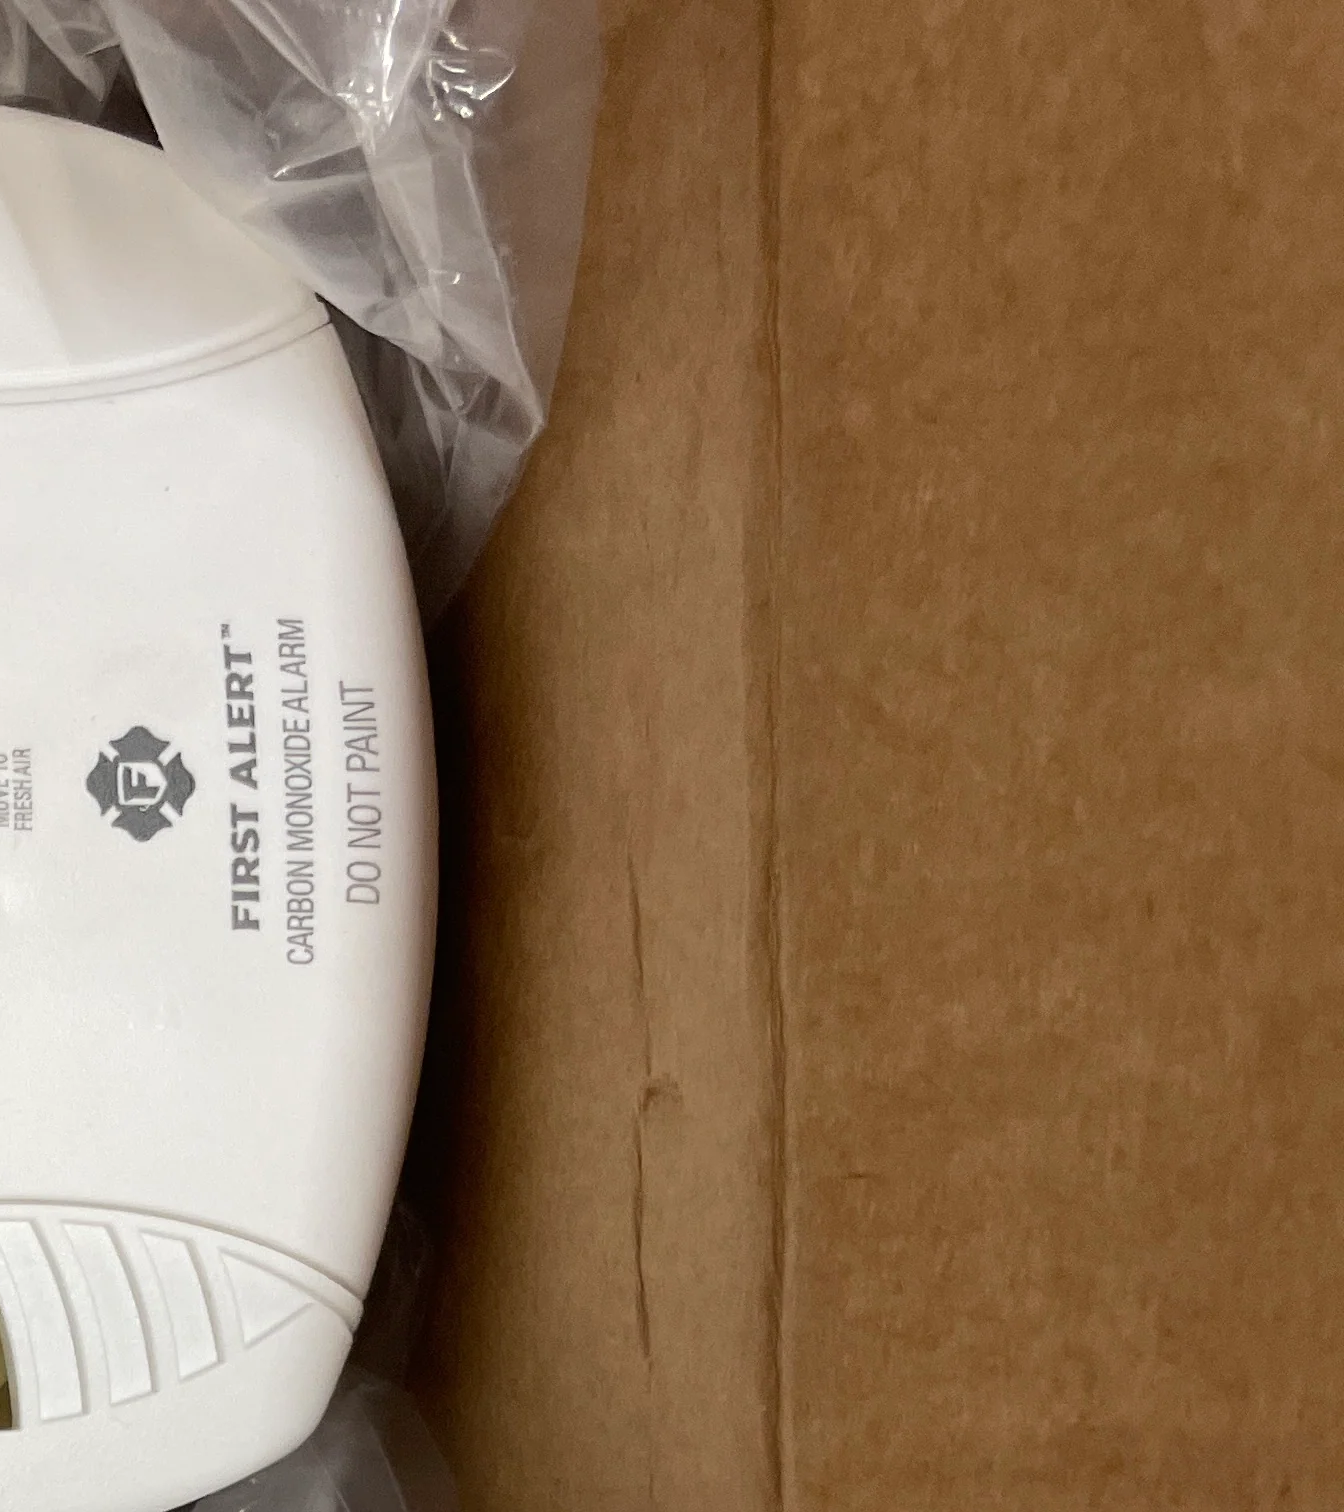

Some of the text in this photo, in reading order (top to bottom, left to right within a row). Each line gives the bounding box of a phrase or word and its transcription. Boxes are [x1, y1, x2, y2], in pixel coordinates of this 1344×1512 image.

[11, 748, 34, 831] FRESH AIR
[228, 802, 261, 931] FIRST
[276, 618, 315, 965] CARBON MONOXIDE ALARM
[339, 680, 382, 905] DO NOT PAINT
